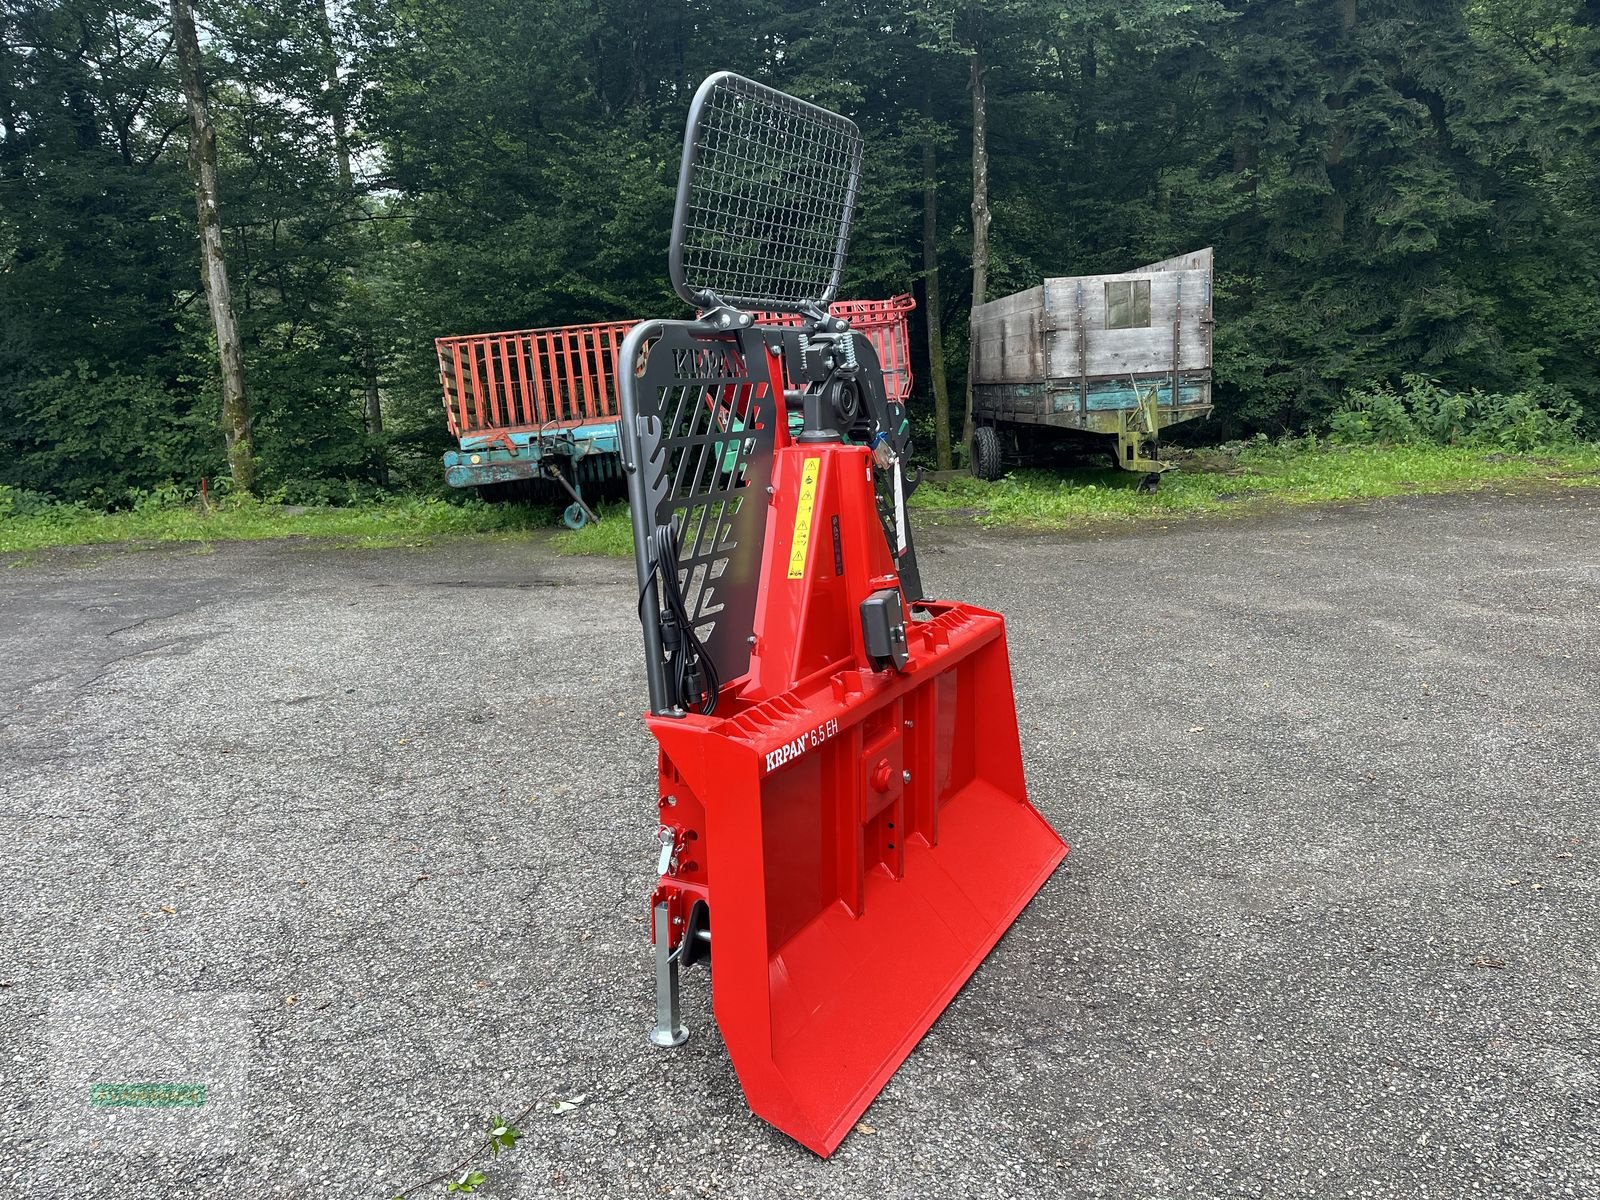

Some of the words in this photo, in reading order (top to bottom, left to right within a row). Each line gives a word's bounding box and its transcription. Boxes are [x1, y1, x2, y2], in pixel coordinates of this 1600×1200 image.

[672, 348, 748, 379] KRPAN
[810, 724, 825, 747] 6,5
[825, 717, 839, 738] EH
